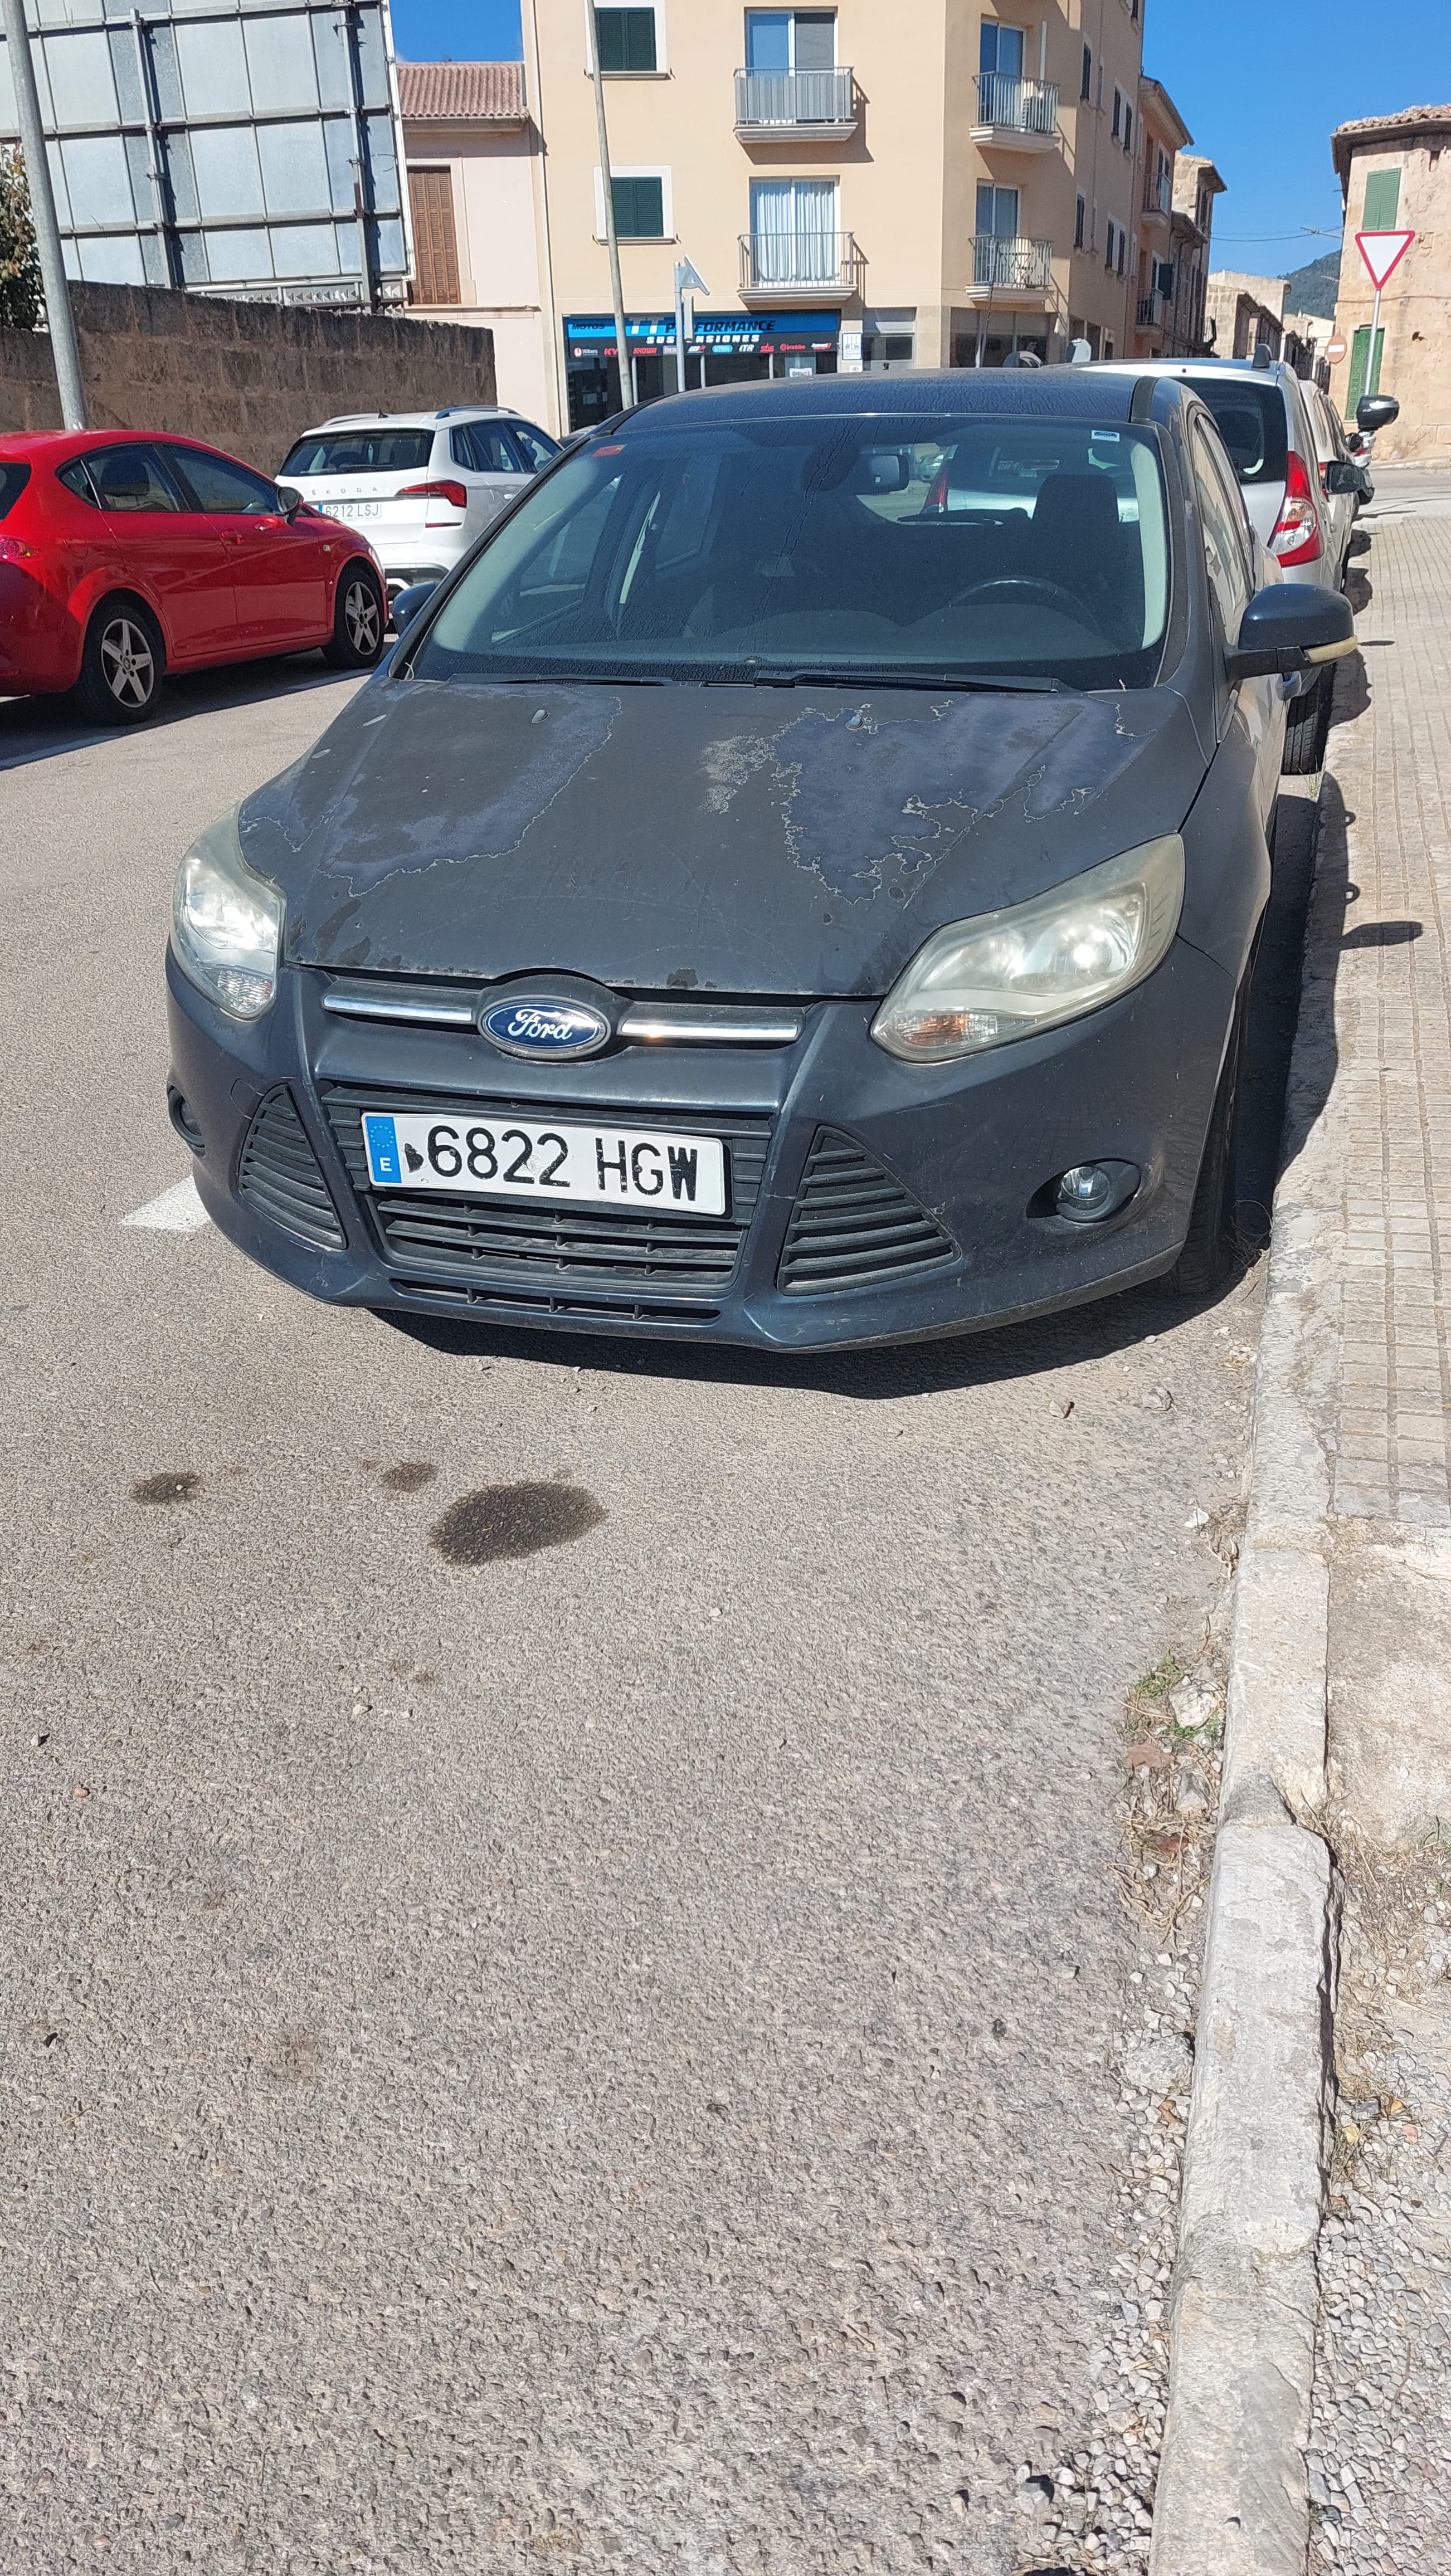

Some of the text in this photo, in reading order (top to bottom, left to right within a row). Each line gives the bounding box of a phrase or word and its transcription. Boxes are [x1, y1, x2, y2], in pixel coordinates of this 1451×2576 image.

[628, 316, 776, 334] TT PFORMANCE
[646, 334, 760, 344] SUSNSIONES
[325, 504, 379, 518] 6212 LSJ
[508, 1008, 573, 1040] Ford
[380, 1157, 392, 1172] E
[427, 1125, 698, 1202] 6822 HGW
